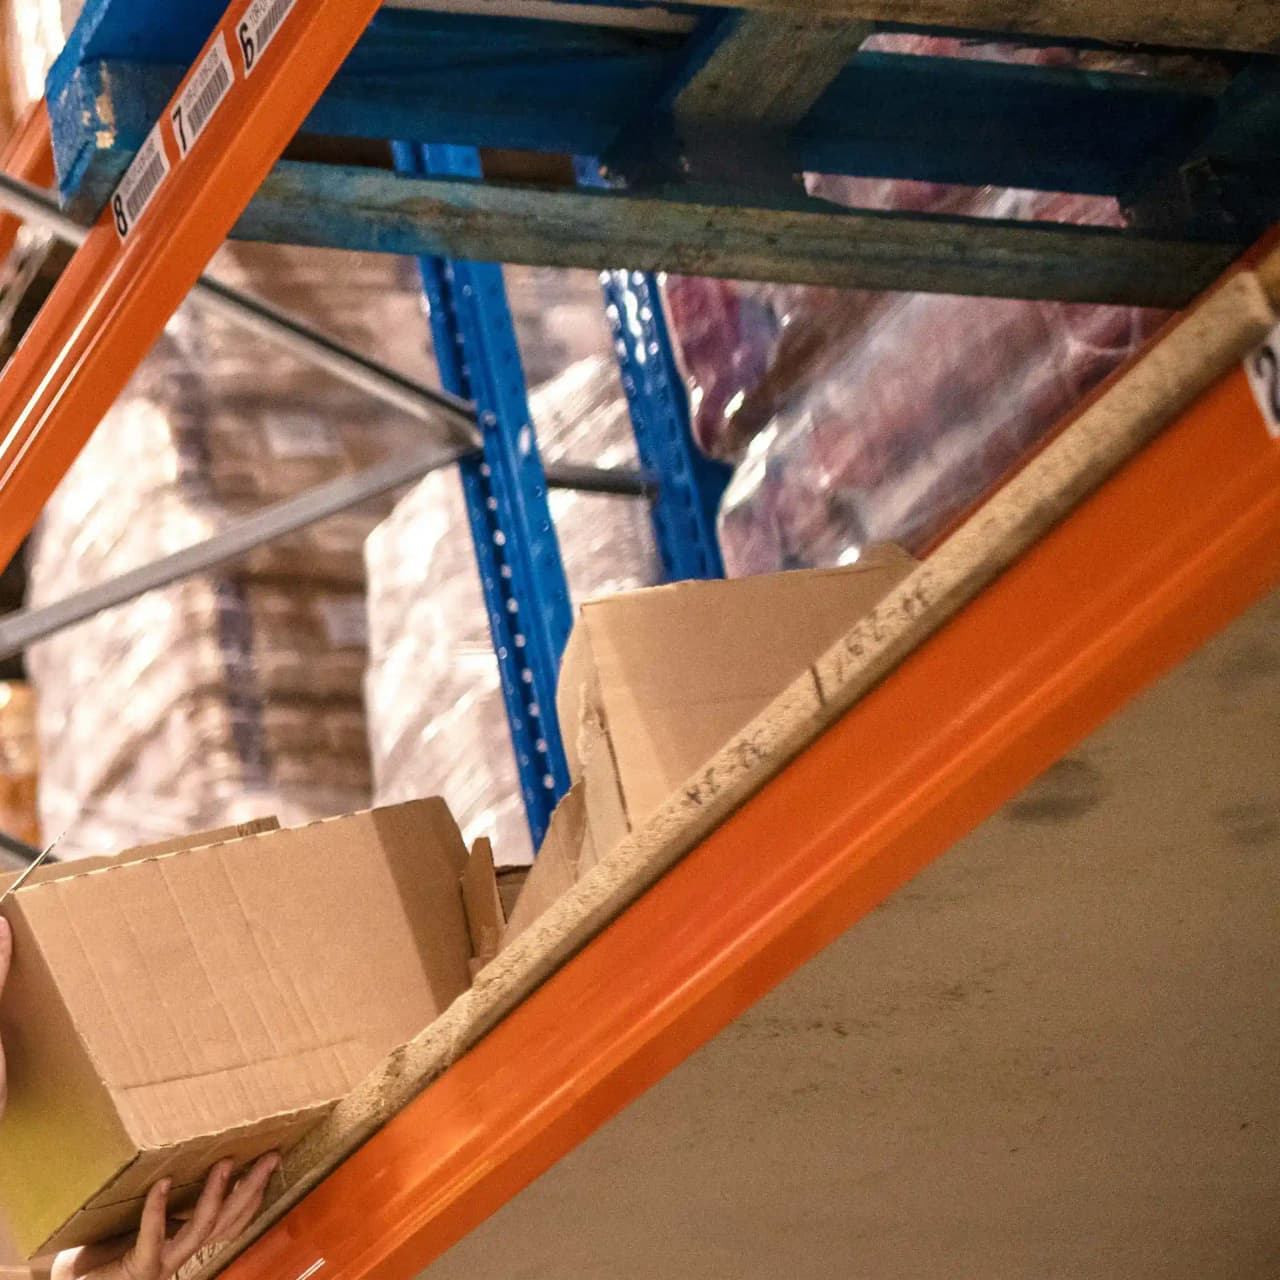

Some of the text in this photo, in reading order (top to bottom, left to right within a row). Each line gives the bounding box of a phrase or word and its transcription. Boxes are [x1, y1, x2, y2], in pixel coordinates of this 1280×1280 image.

[239, 22, 255, 70] 6
[172, 105, 187, 152] 7
[113, 193, 128, 237] 8
